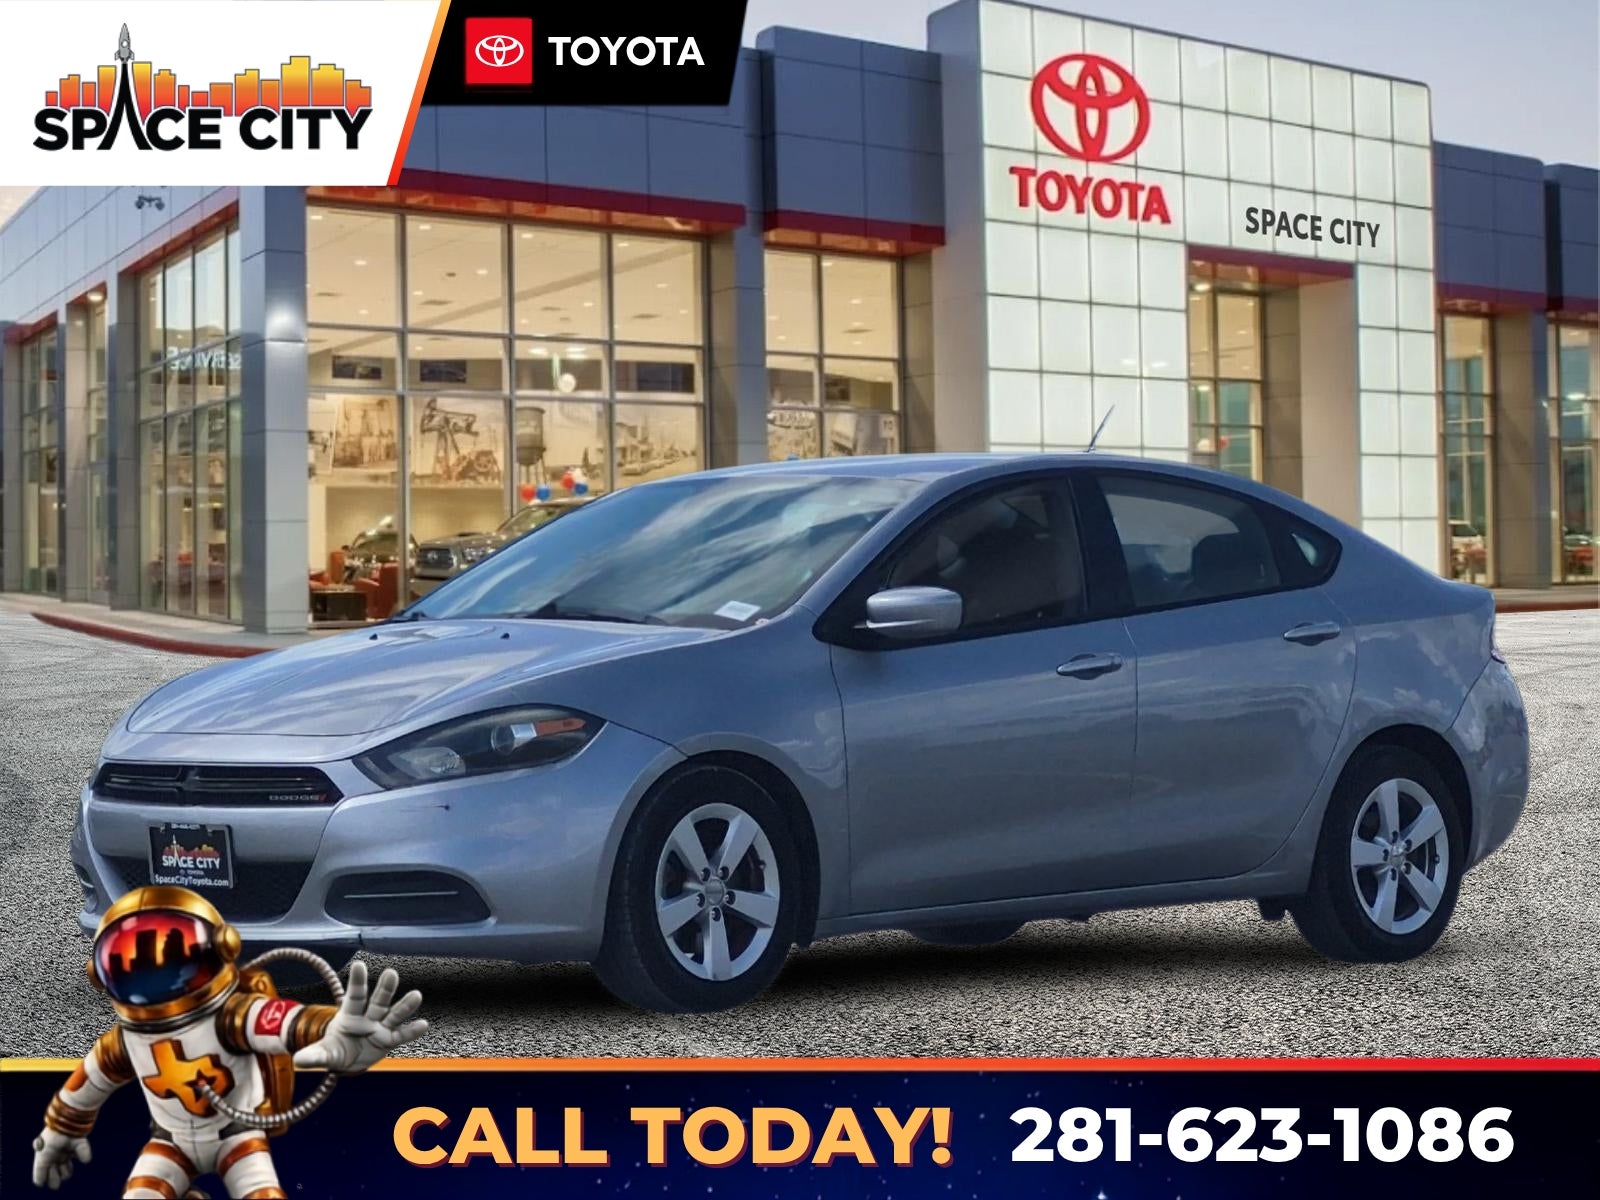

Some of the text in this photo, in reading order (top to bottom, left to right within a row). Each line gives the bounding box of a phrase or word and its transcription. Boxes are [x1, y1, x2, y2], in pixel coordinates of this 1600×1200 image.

[1009, 166, 1171, 224] TOYOTA
[1245, 206, 1381, 248] SPACE CITY
[268, 794, 321, 802] DODGE
[162, 854, 221, 870] SPACE CITY
[155, 873, 229, 887] SpaceCityToyota.com
